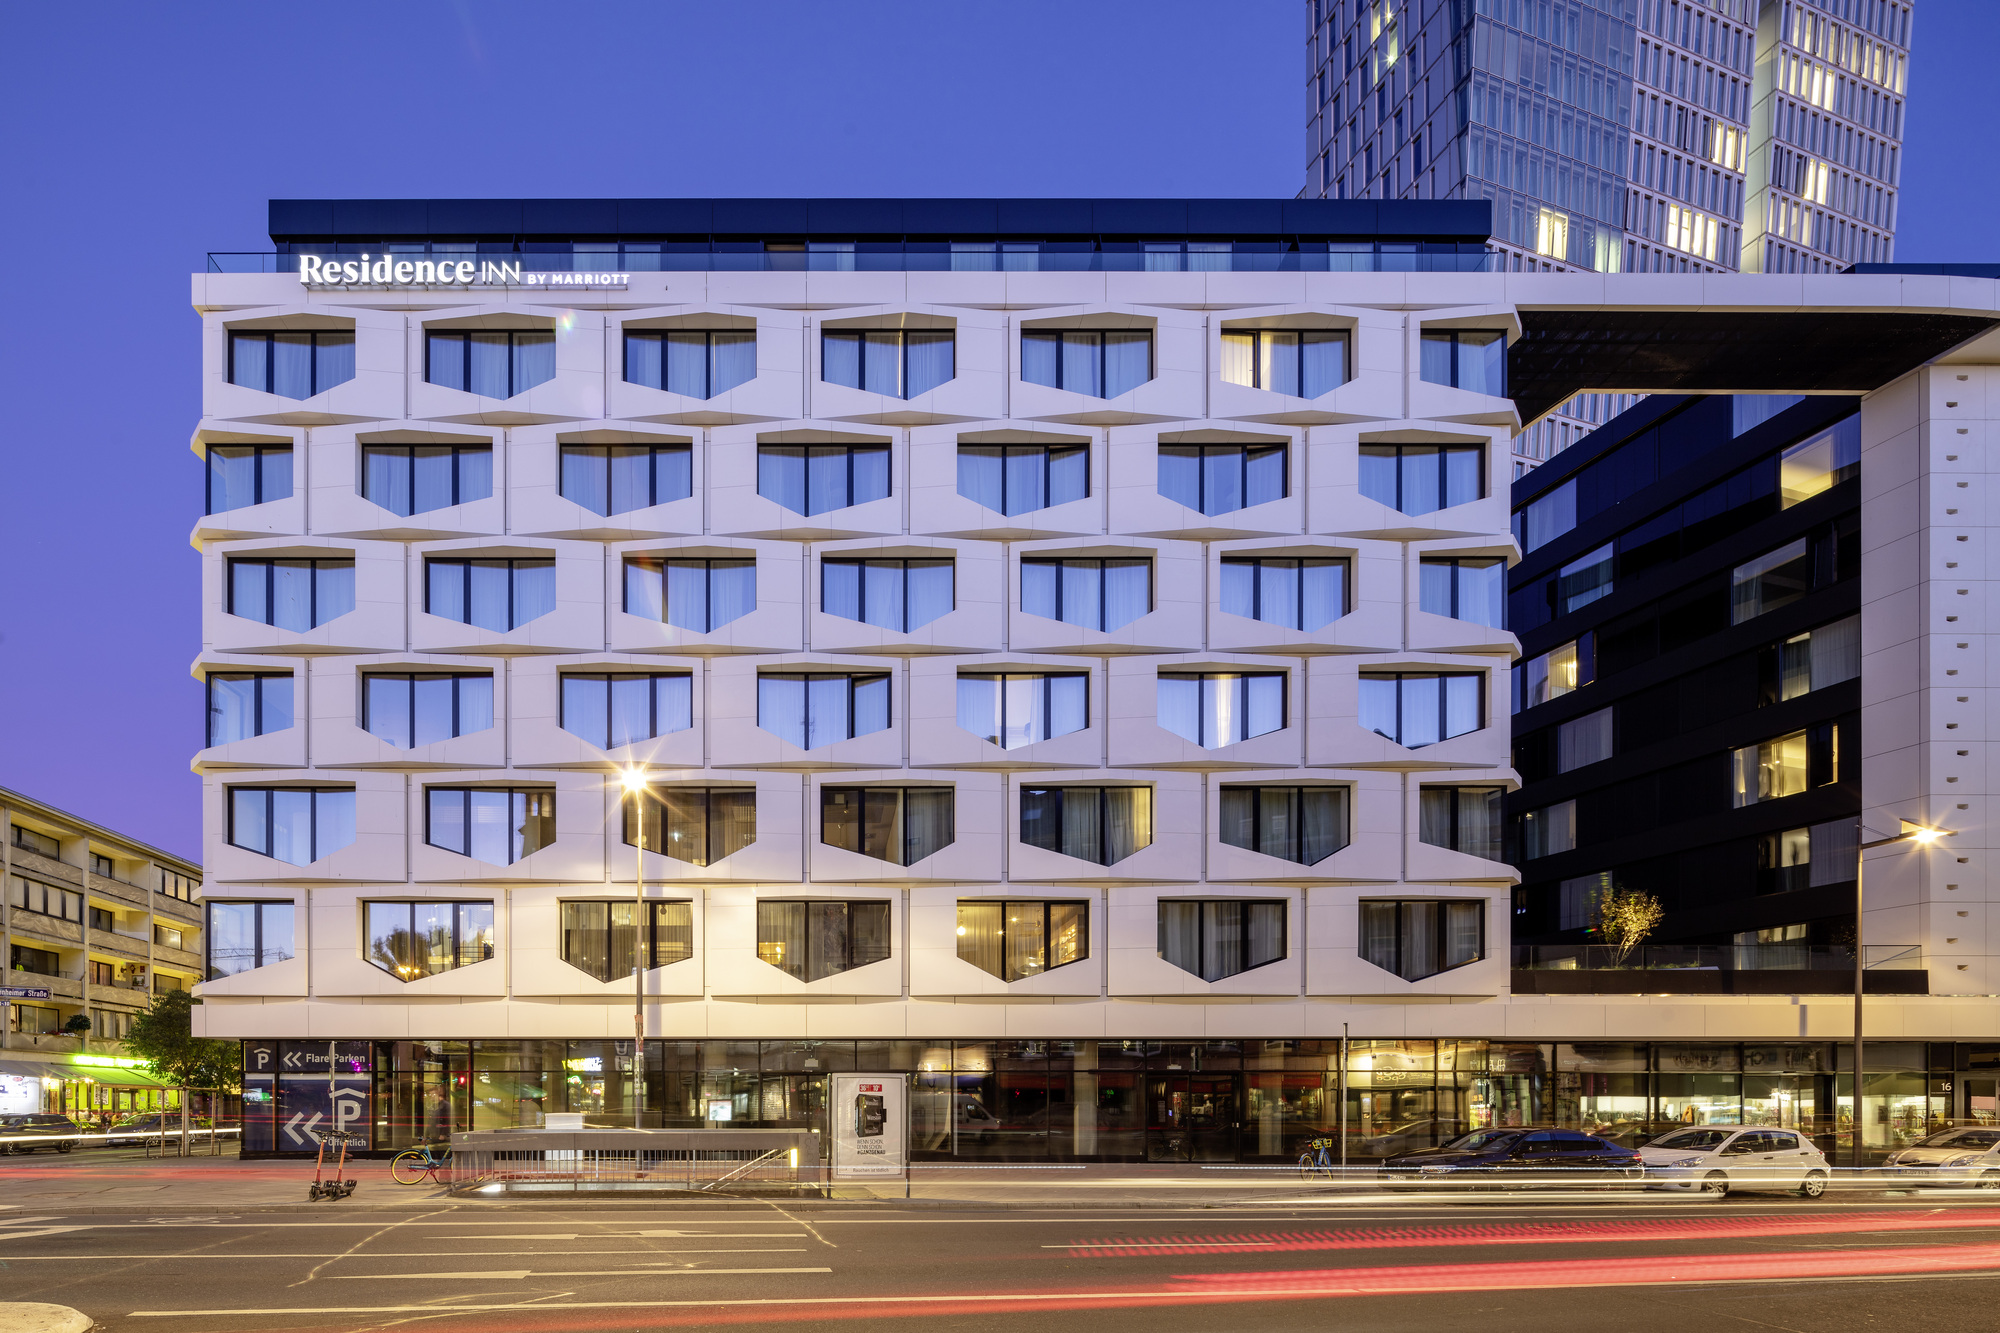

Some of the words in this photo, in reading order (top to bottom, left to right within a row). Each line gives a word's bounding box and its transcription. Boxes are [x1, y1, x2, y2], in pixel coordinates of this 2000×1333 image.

[299, 253, 476, 284] Residence
[482, 261, 520, 284] INN
[527, 273, 546, 285] BY
[552, 273, 630, 285] MARRIOTT
[257, 1053, 269, 1070] P
[306, 1053, 330, 1063] Flare
[333, 1053, 366, 1063] Parken
[1941, 1082, 1952, 1091] 16
